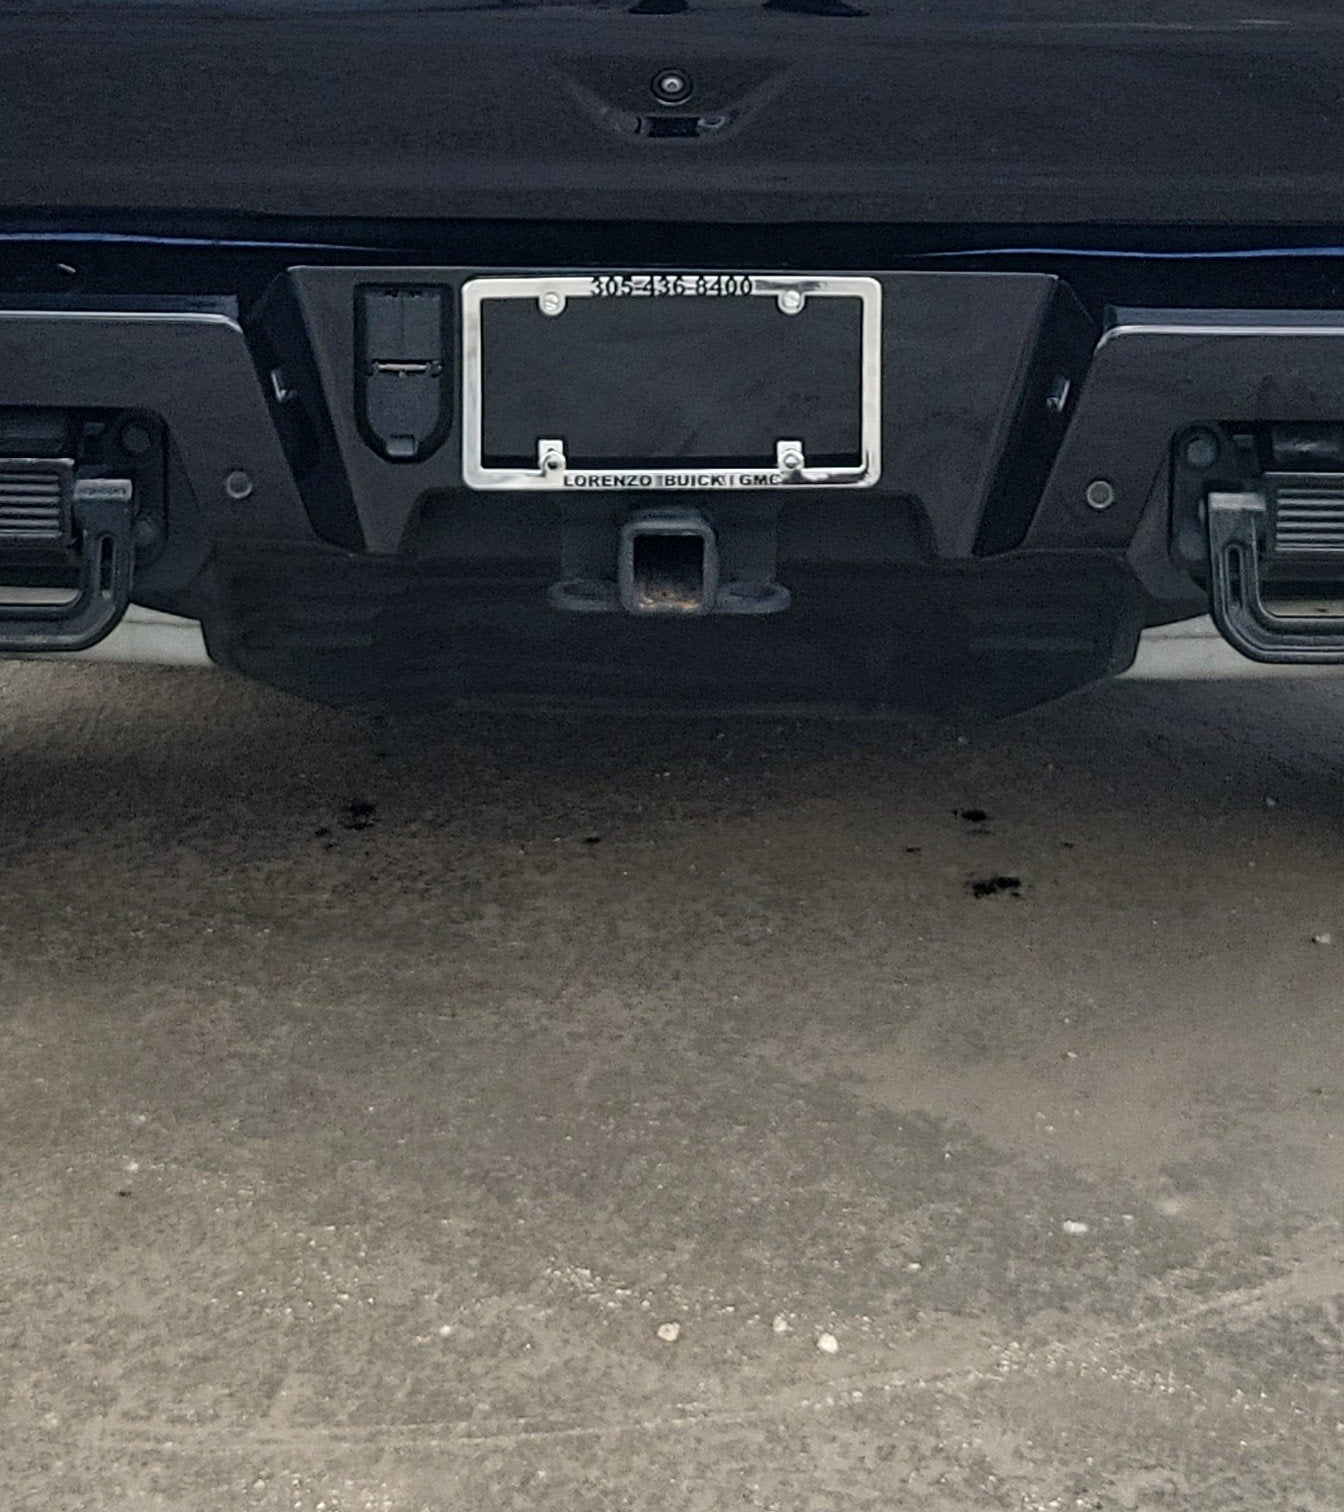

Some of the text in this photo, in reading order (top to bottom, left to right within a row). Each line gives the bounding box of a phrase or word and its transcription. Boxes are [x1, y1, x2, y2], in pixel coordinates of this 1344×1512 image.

[563, 473, 782, 488] LORENZO BUICK GMC
